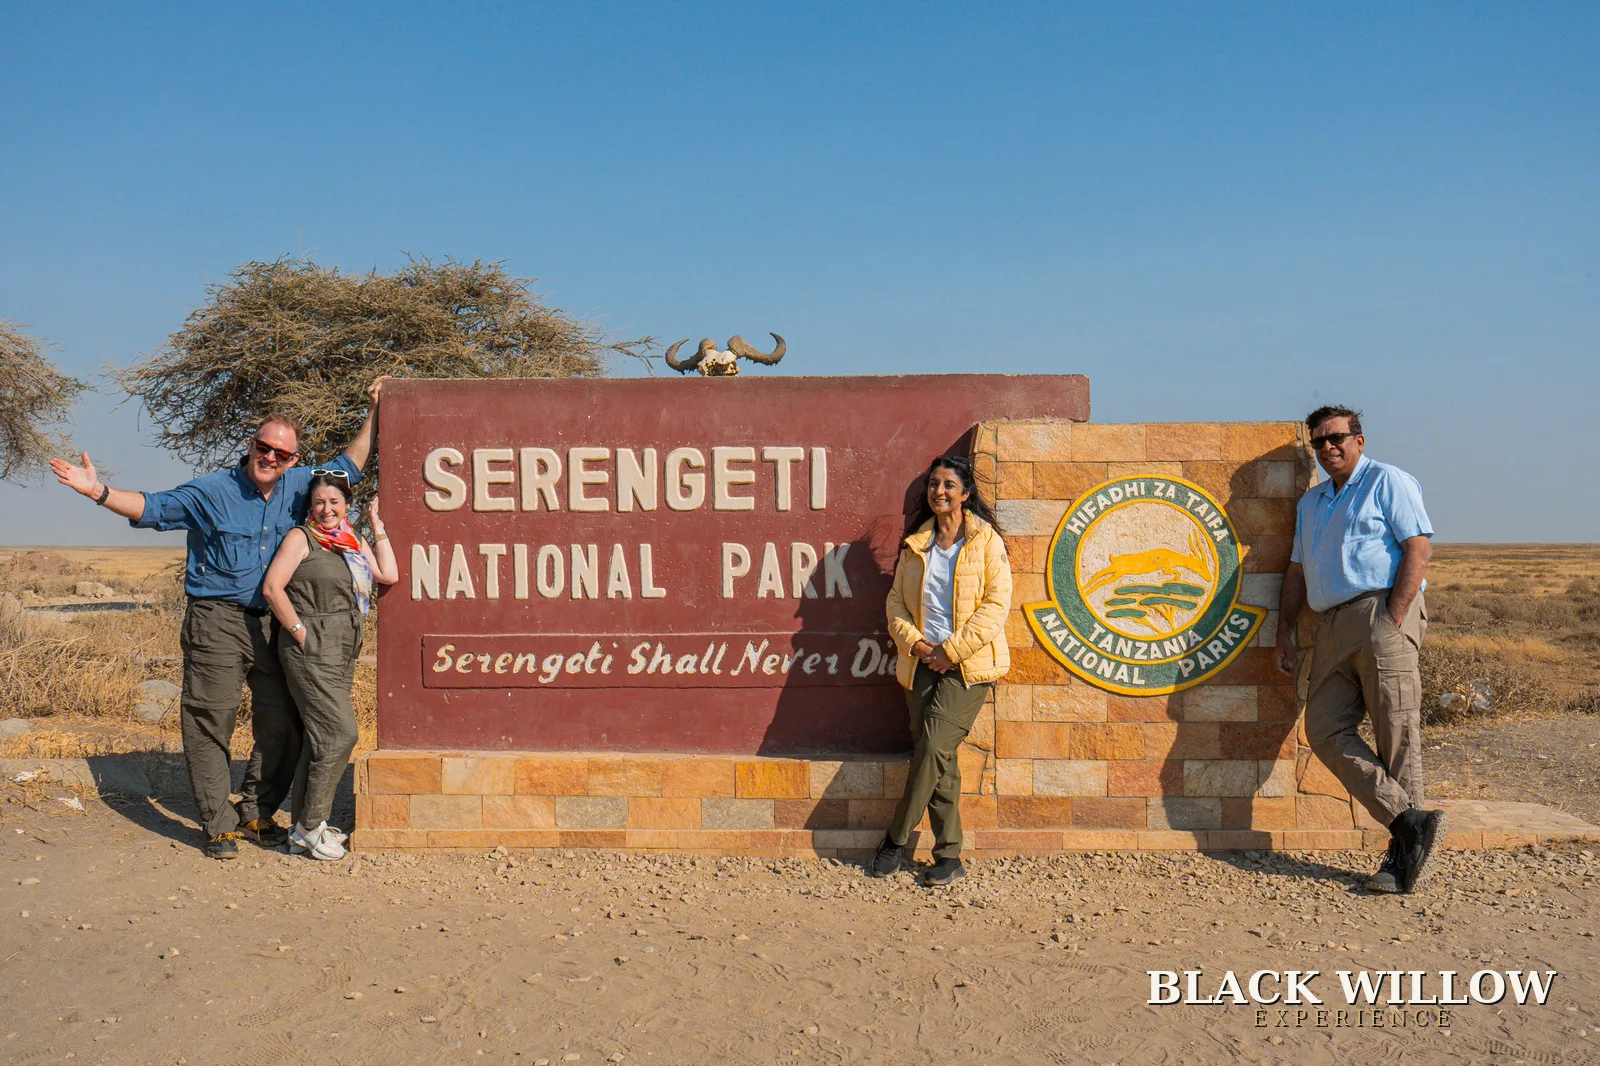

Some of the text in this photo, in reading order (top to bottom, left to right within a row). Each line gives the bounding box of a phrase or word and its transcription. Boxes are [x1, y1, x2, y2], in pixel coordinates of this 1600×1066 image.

[423, 446, 828, 512] SERENGETI
[1065, 481, 1231, 543] HIFADHI ZA TAIFA
[410, 541, 852, 600] NATIONAL PARK
[432, 640, 618, 684] Serengeti
[626, 641, 729, 675] Shall
[730, 638, 839, 677] Never
[1041, 612, 1251, 686] NATIONAL PARKS
[1087, 623, 1203, 660] TANZANIA
